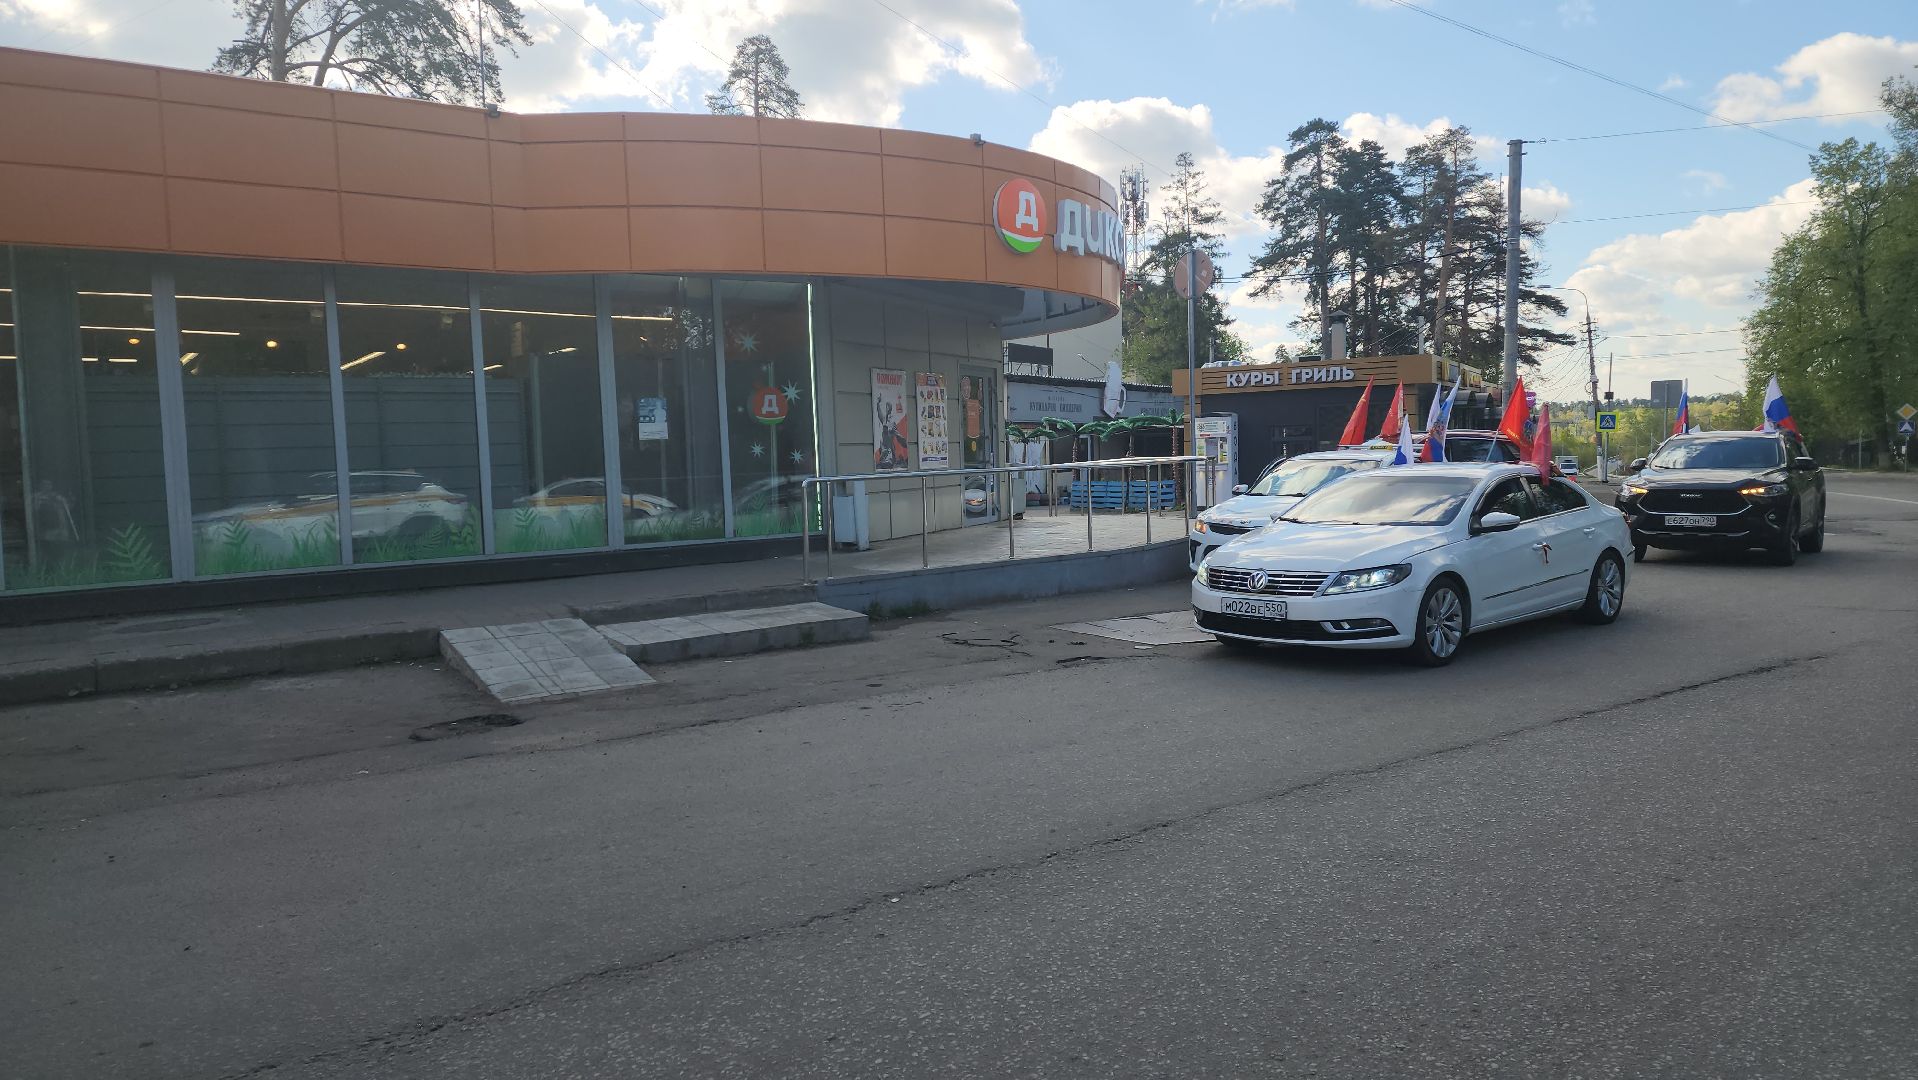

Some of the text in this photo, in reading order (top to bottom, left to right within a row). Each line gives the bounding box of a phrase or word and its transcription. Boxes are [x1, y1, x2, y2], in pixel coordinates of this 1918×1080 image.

[1015, 190, 1038, 231] Д
[1226, 366, 1355, 388] КУРЫ ГРИЛЬ
[1225, 600, 1263, 615] М022ВЕ
[1265, 602, 1283, 613] 550
